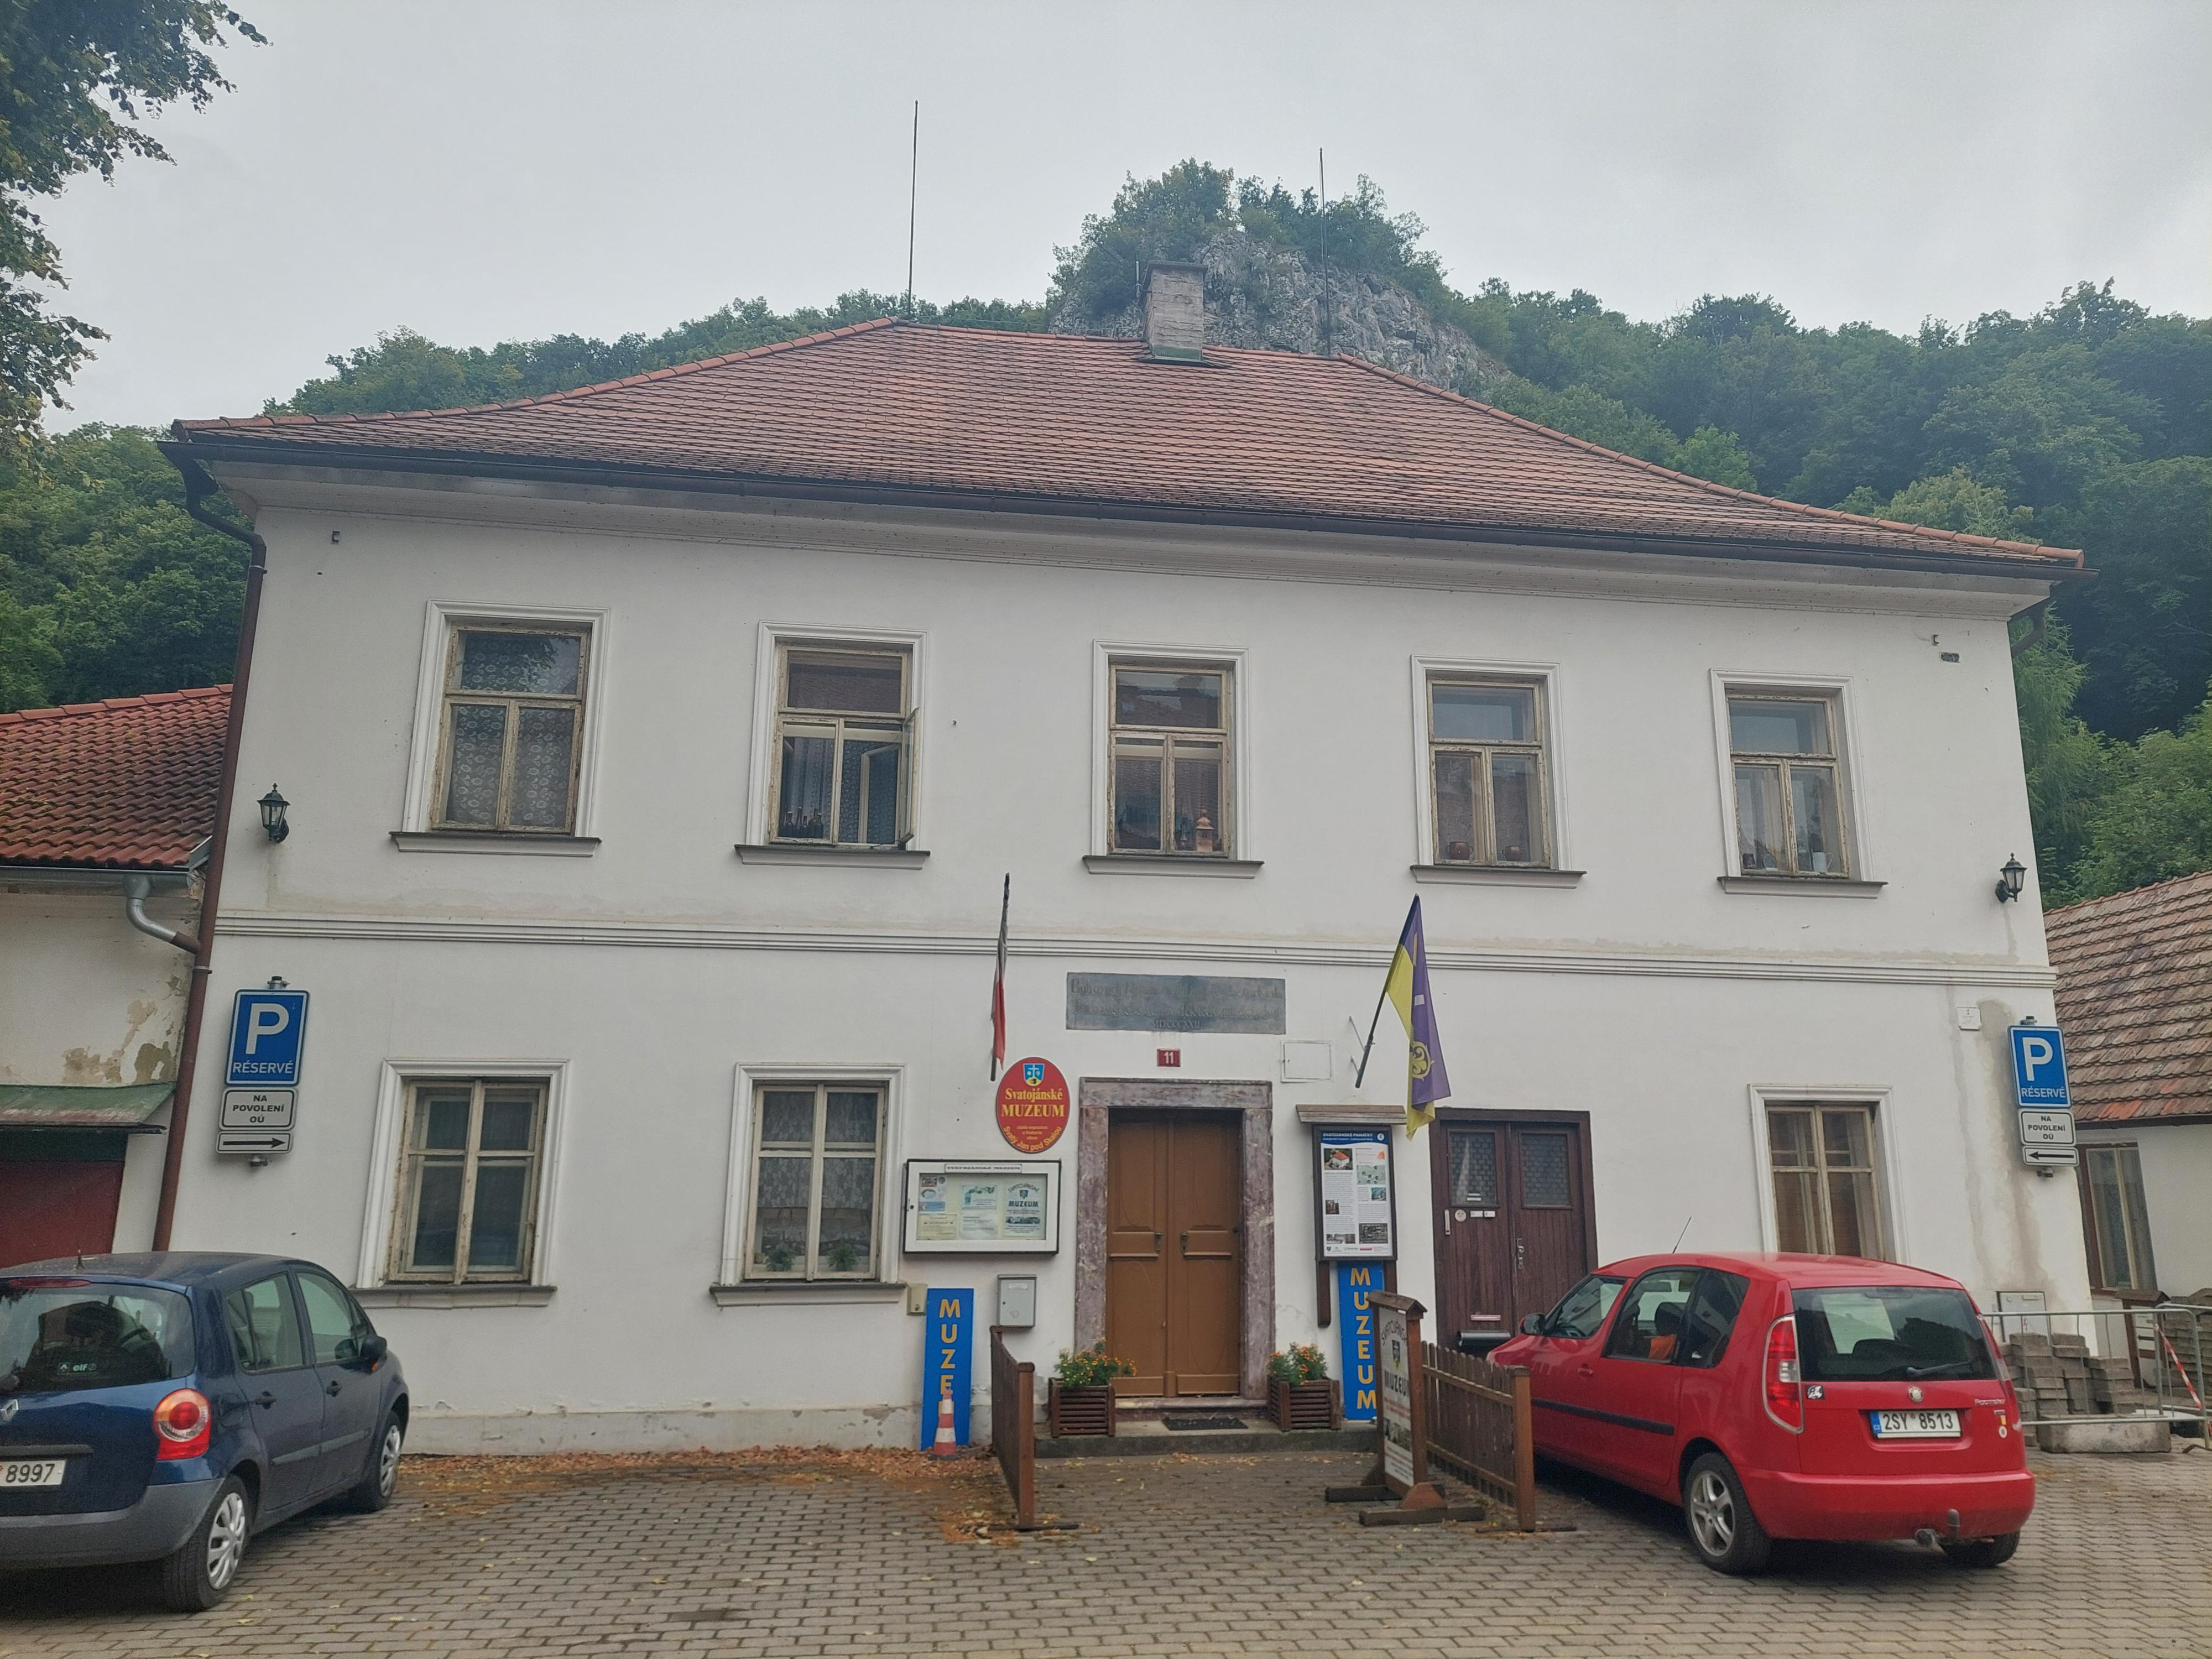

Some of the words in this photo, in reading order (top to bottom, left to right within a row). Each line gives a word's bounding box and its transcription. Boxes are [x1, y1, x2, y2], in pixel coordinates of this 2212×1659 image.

[246, 1003, 289, 1055] P
[1164, 1051, 1173, 1064] 11
[2022, 1037, 2053, 1082] P
[232, 1060, 294, 1074] RÉSERVÉ
[1005, 1088, 1063, 1103] Svatojánské
[2021, 1086, 2066, 1099] RÉSERVÉ
[232, 1104, 284, 1113] POVOLENÍ
[1001, 1104, 1065, 1117] MUZEUM
[250, 1114, 264, 1123] OÚ
[1004, 1126, 1018, 1144] Svatý
[1017, 1141, 1029, 1150] Jan
[1030, 1141, 1044, 1151] pod
[1043, 1126, 1062, 1146] Skalou
[1350, 1267, 1377, 1410] MUZEUM
[938, 1298, 961, 1416] MUZE
[1883, 1413, 1907, 1430] 2SY
[1919, 1412, 1953, 1430] 8513
[6, 1463, 55, 1483] 8997
